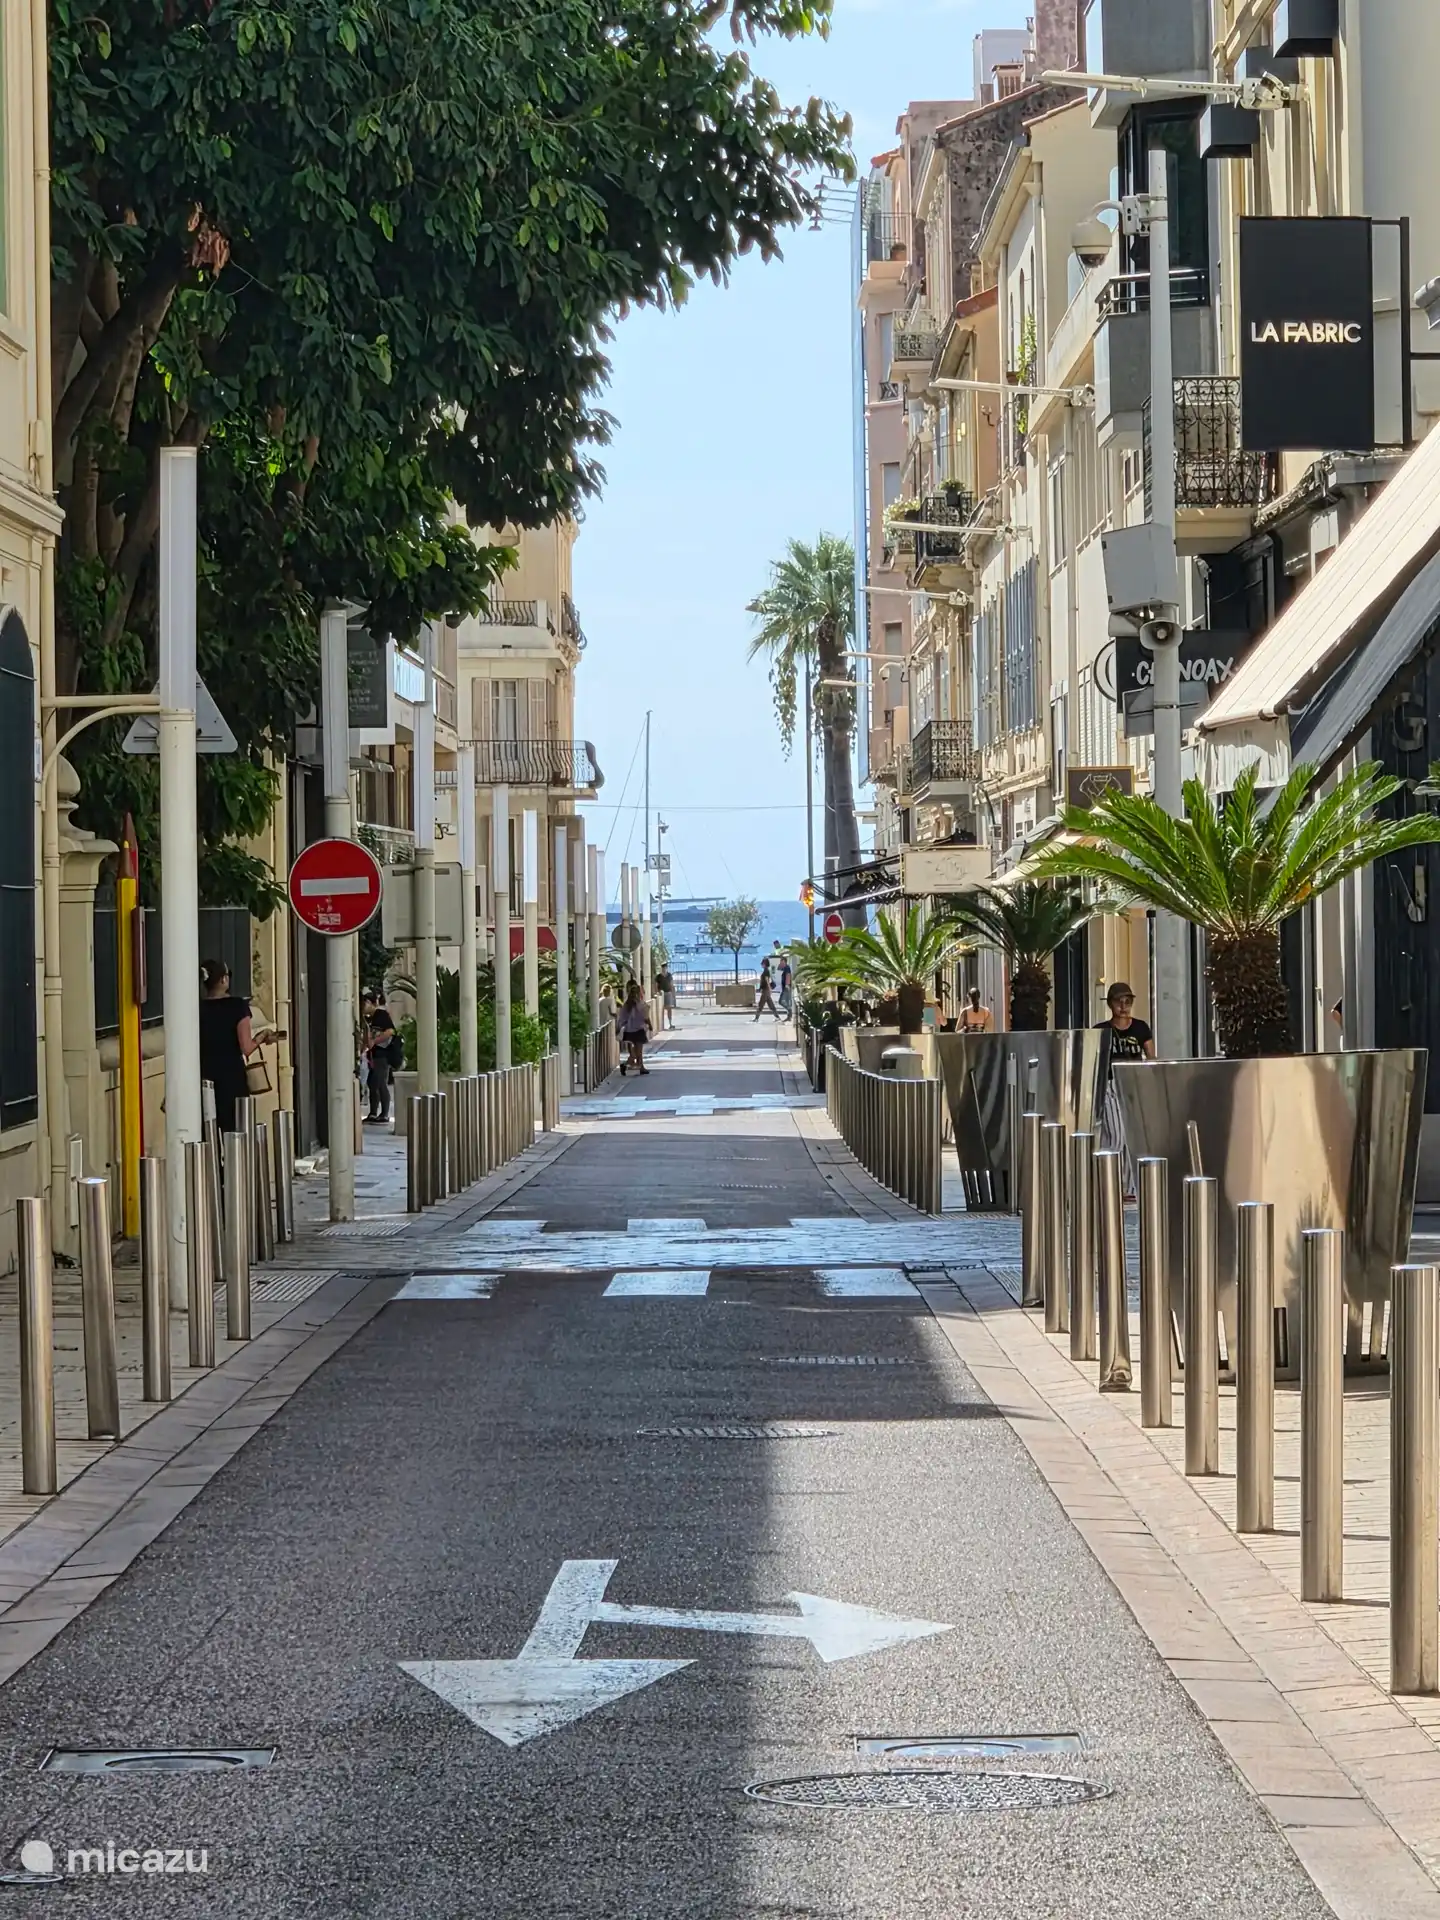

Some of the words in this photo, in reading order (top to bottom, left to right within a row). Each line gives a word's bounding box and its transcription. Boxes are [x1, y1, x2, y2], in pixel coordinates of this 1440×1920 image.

[1251, 321, 1280, 343] LA
[1284, 322, 1361, 343] FABRIC
[1136, 656, 1234, 685] CNOAX
